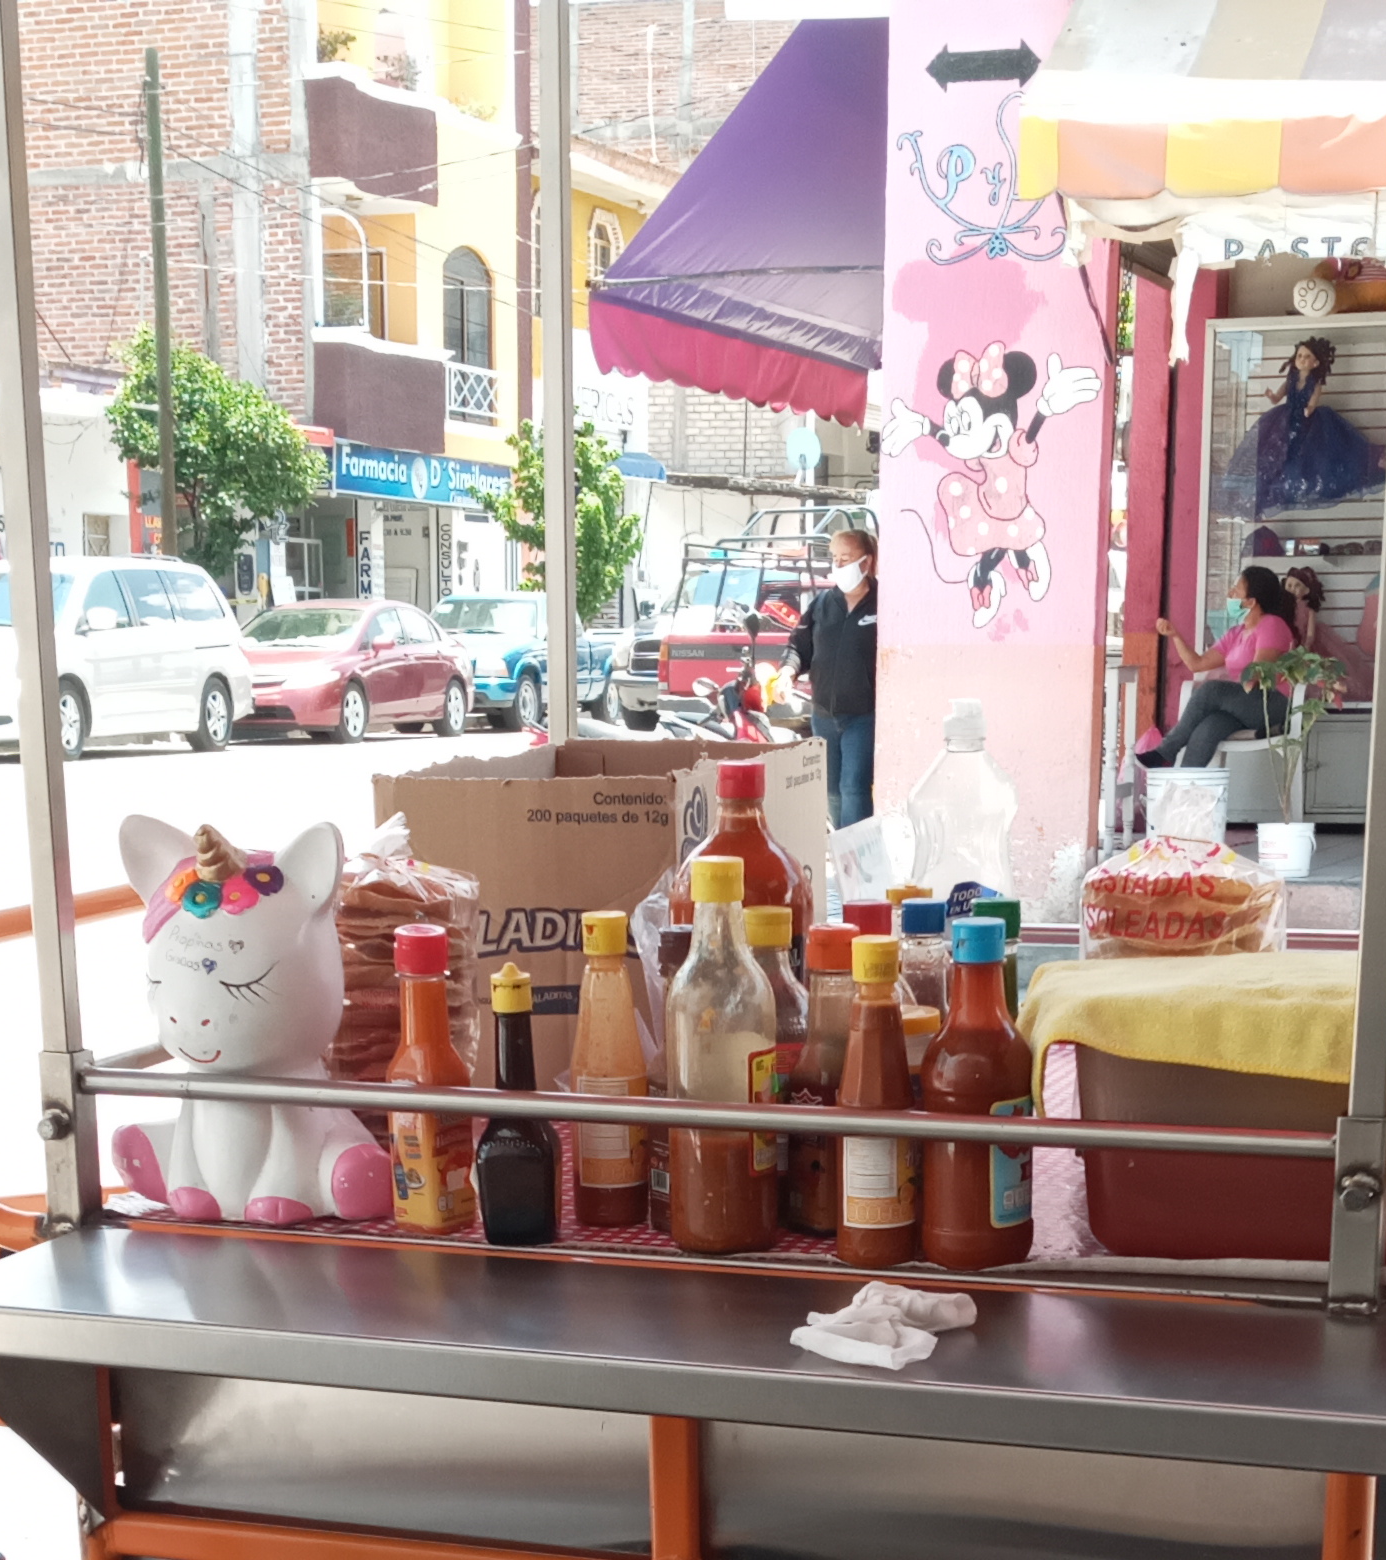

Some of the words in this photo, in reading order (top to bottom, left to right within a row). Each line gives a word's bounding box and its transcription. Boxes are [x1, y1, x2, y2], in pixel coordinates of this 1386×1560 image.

[341, 446, 408, 484] Farmacia
[593, 792, 667, 806] Contenido:
[527, 809, 551, 823] 200
[556, 810, 618, 826] paquetes
[622, 811, 639, 823] de
[644, 812, 669, 826] 12g
[953, 887, 983, 903] TODO
